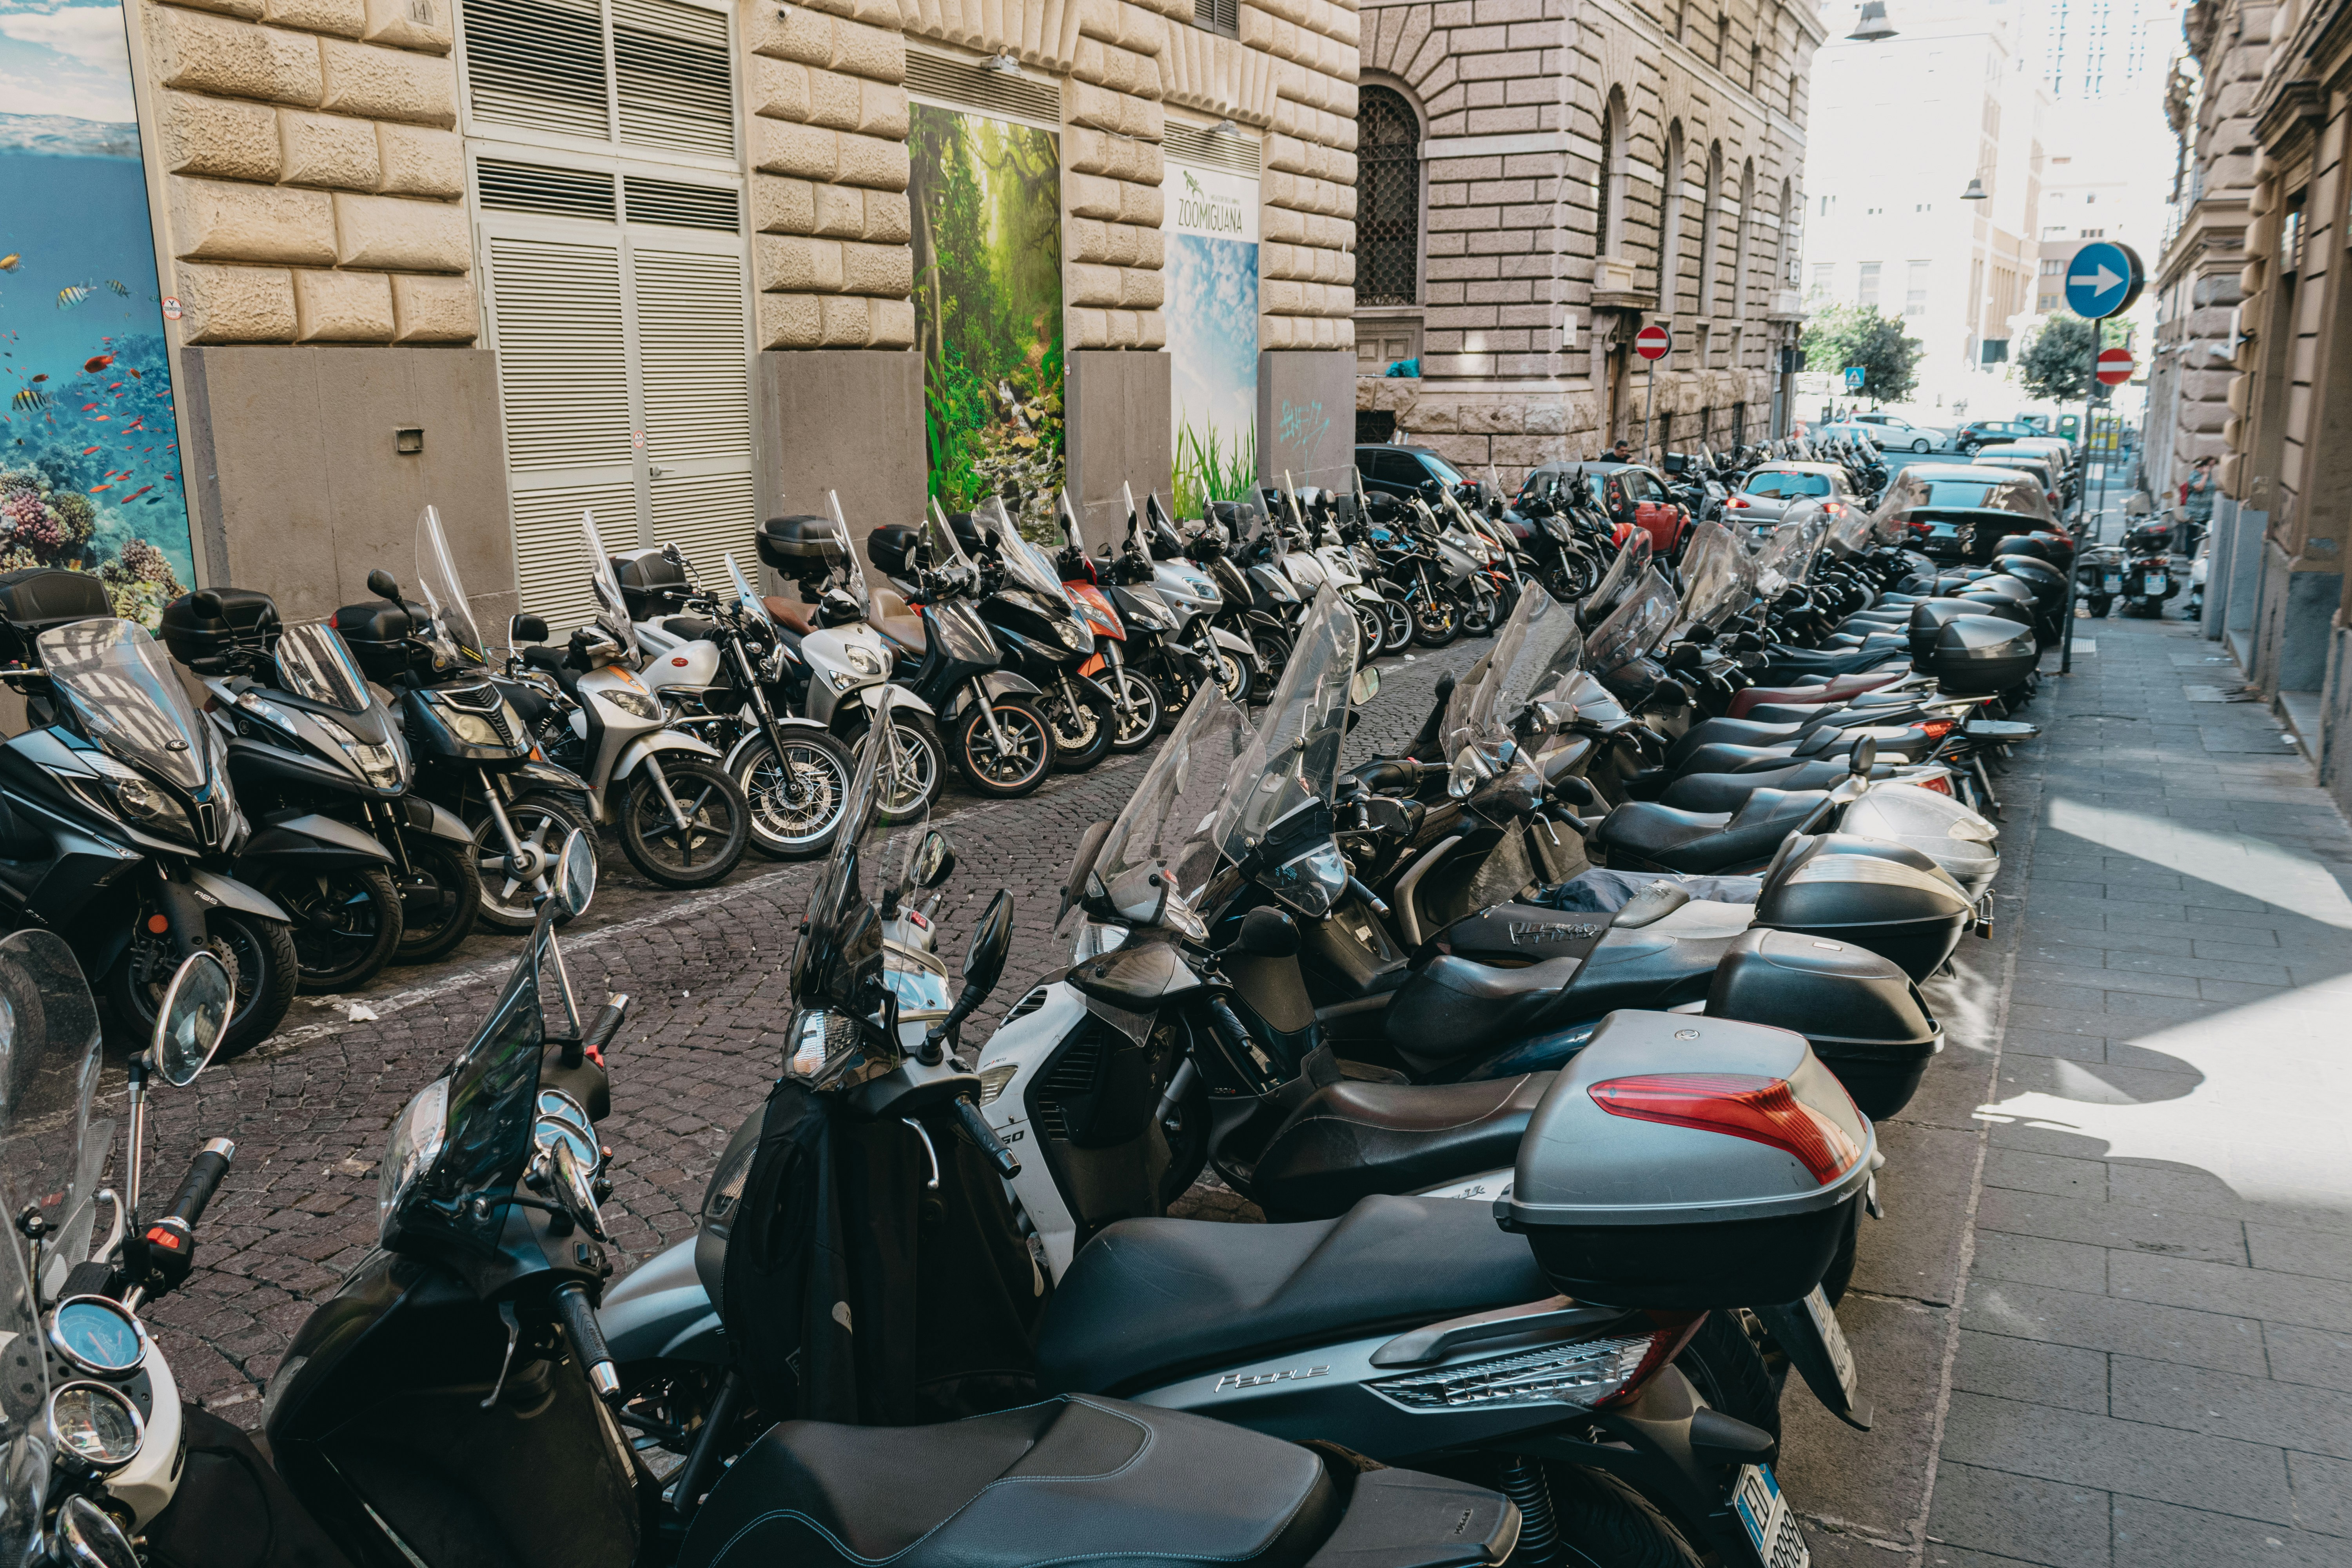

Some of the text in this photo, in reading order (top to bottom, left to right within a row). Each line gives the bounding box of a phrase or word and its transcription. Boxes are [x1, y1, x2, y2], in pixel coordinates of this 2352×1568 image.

[1178, 198, 1242, 234] ZOOMIGUANA
[194, 891, 218, 905] ABS
[1743, 1475, 1769, 1532] ED
